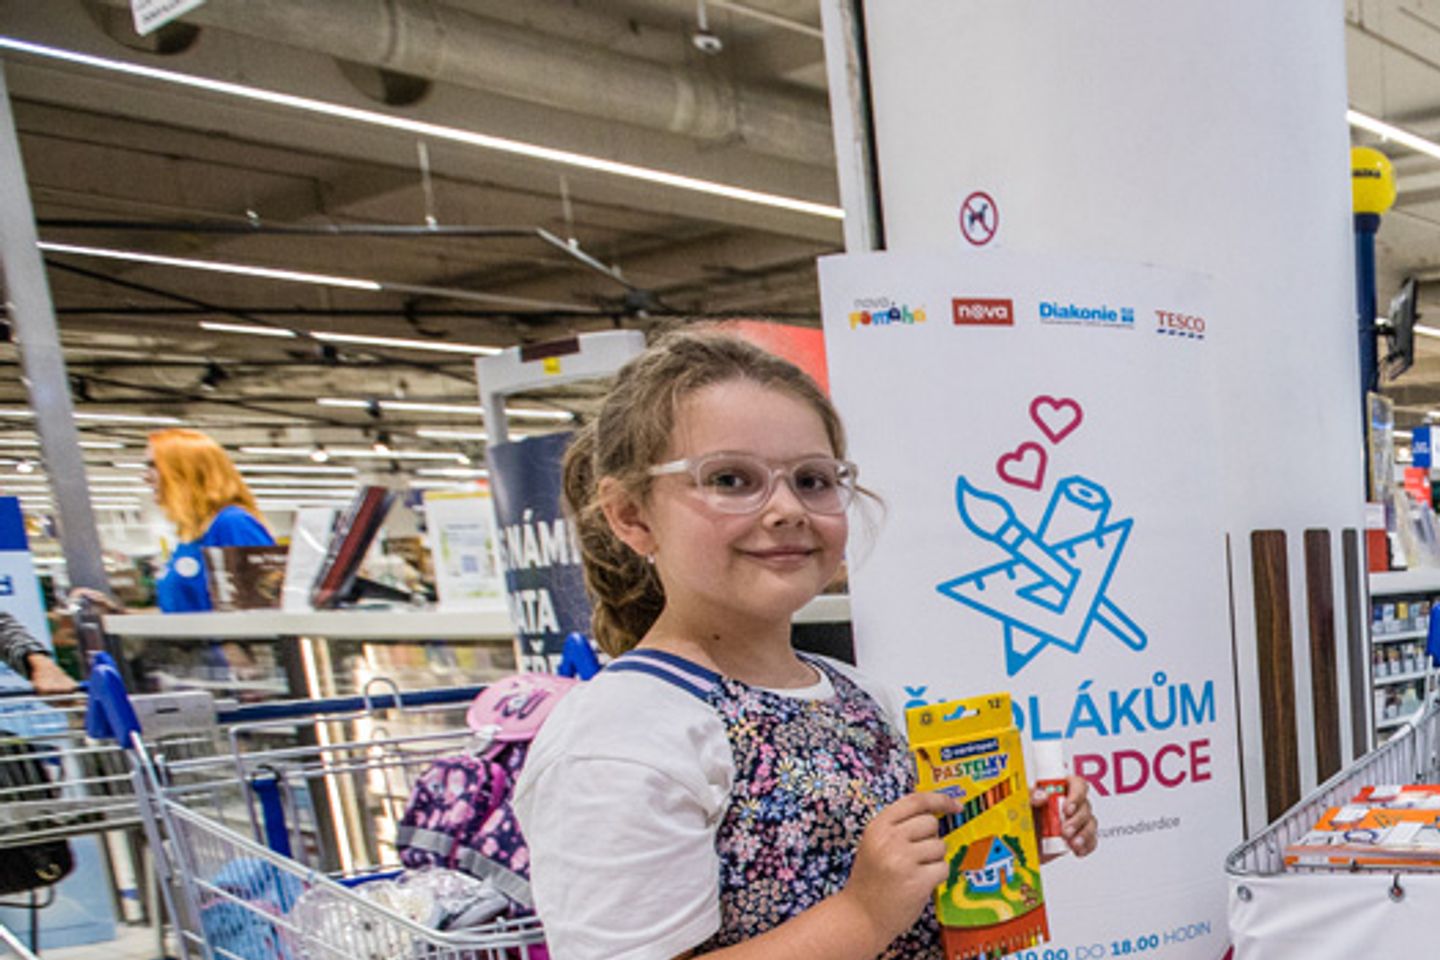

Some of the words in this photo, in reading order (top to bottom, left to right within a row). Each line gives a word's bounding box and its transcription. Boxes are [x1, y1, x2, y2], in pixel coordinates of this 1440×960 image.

[1039, 302, 1118, 323] Diakonie
[1155, 310, 1206, 333] TESCO
[1071, 738, 1213, 798] RDCE
[1110, 934, 1159, 957] 18.00
[1163, 921, 1211, 943] HODIN
